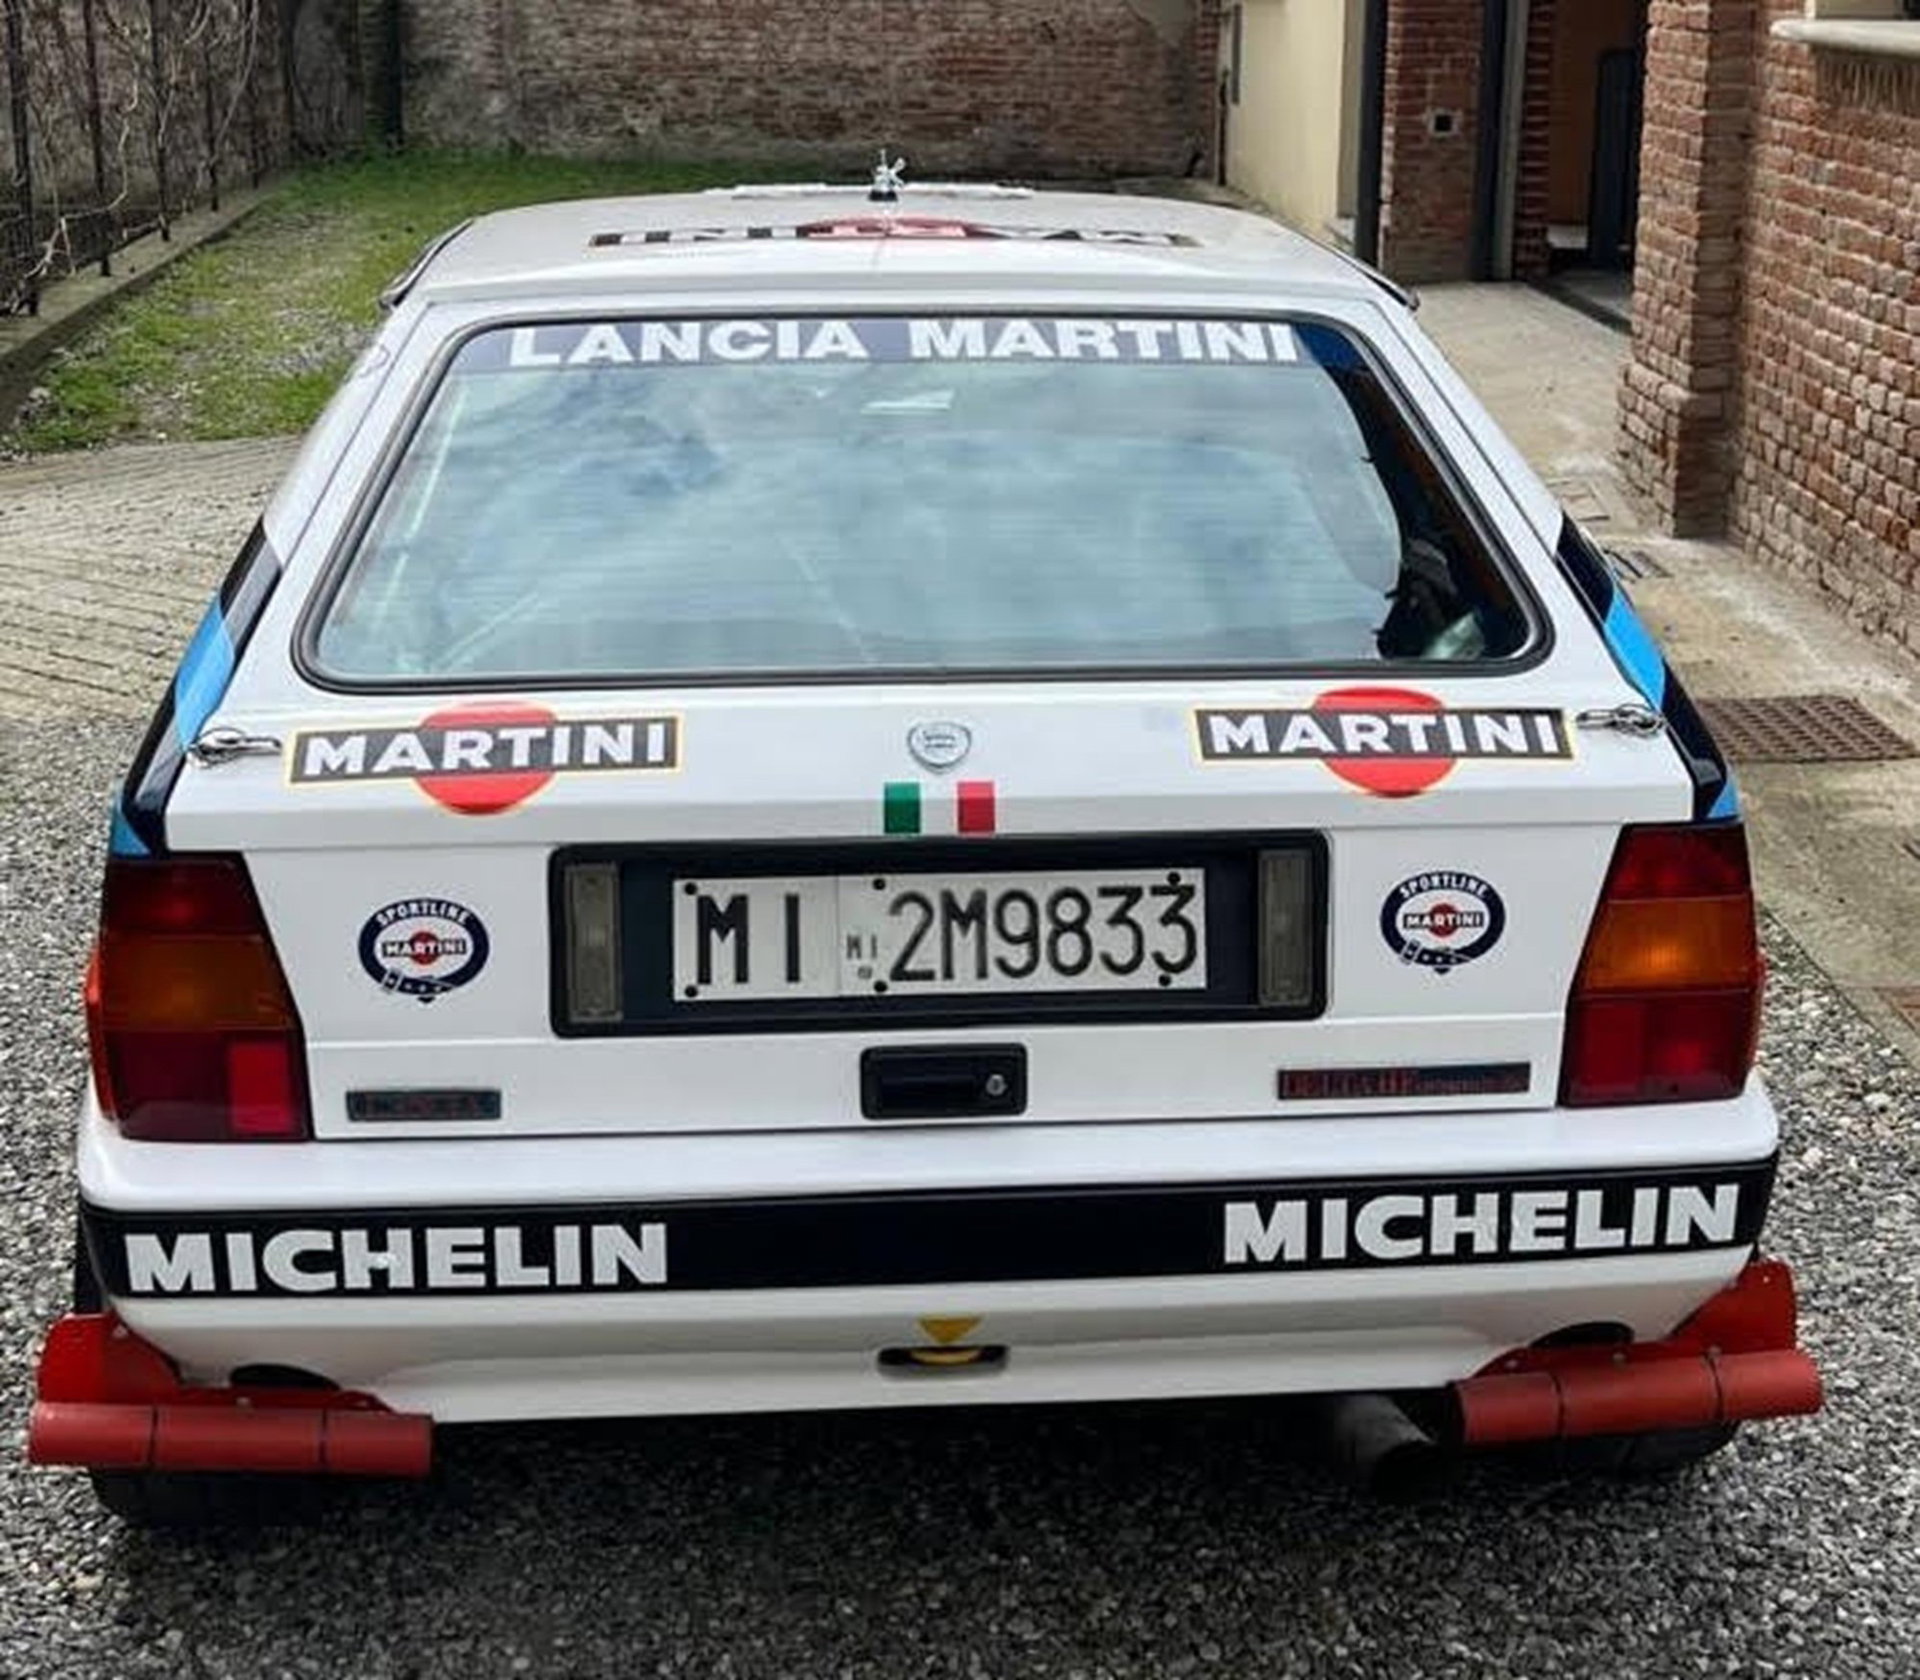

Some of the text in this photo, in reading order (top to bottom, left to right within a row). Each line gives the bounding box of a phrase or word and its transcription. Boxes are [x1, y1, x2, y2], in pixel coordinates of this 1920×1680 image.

[510, 317, 1297, 367] LANCIA MARTINI
[303, 723, 666, 777] MARTINI
[1207, 714, 1559, 754] MARTINI
[1400, 874, 1489, 899] SPORTLINE
[375, 902, 470, 927] SPORTLINE
[887, 884, 1199, 982] 2M9833
[1406, 912, 1481, 927] MARTINI
[385, 940, 465, 956] MARTINI
[1224, 1184, 1740, 1263] MICHELIN
[124, 1223, 667, 1292] MICHELIN
